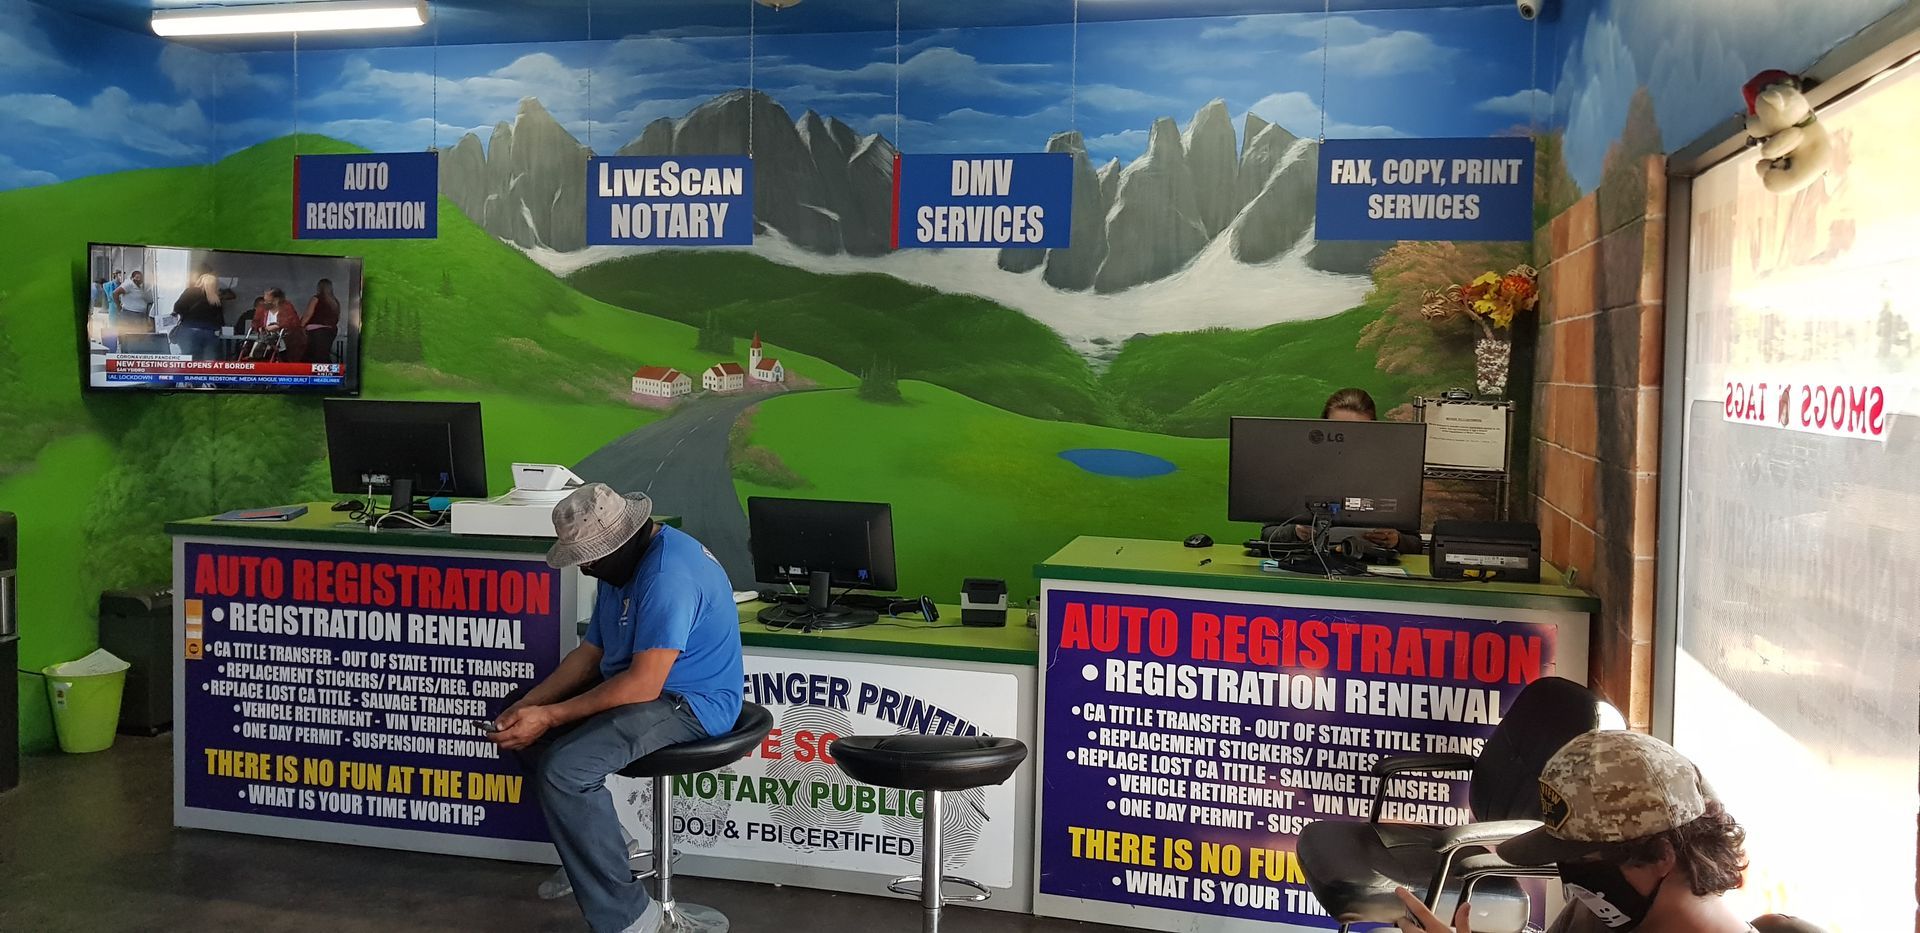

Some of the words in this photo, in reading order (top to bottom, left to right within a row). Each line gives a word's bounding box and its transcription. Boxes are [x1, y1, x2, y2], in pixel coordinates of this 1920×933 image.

[343, 161, 389, 191] AUTO
[951, 159, 1014, 197] DMV
[1330, 159, 1377, 187] FAX,
[1382, 158, 1446, 187] COPY,
[1451, 158, 1523, 185] PRINT
[306, 201, 426, 230] REGISTRATION
[610, 202, 729, 239] NOTARY
[916, 205, 1044, 243] SERVICES
[1368, 193, 1480, 220] SERVICES
[169, 361, 186, 369] SITE
[312, 363, 329, 373] FOX
[1327, 432, 1345, 443] LG
[194, 553, 284, 600] AUTO
[293, 559, 550, 615] REGISTRATION
[229, 602, 401, 642] REGISTRATION
[407, 613, 525, 650] RENEWAL
[1060, 602, 1179, 657] AUTO
[1191, 612, 1543, 685] REGISTRATION
[213, 640, 231, 658] CA
[233, 642, 266, 661] TITLE
[268, 645, 332, 666] TRANSFER
[342, 650, 368, 668] OUT
[370, 652, 387, 669] OF
[388, 653, 427, 673] STATE
[429, 656, 464, 675] TITLE
[466, 659, 535, 680] TRANSFER
[226, 662, 313, 685] REPLACEMENT
[315, 669, 384, 690] STICKERS/
[210, 679, 264, 700] REPLACE
[265, 684, 296, 702] LOST
[298, 686, 317, 704] CA
[318, 688, 351, 707] TITLE
[361, 691, 417, 711] SALVAGE
[419, 696, 487, 717] TRANSFER
[1105, 658, 1337, 712] REGISTRATION
[1345, 678, 1504, 726] RENEWAL
[242, 701, 293, 721] VEHICLE
[294, 706, 373, 727] RETIREMENT
[385, 713, 409, 731] VIN
[1083, 702, 1106, 723] CA
[1109, 704, 1153, 728] TITLE
[1156, 709, 1241, 736] TRANSFER
[1255, 718, 1290, 740] OUT
[1293, 722, 1315, 743] OF
[1318, 724, 1370, 748] STATE
[1373, 729, 1420, 753] TITLE
[1424, 733, 1488, 759] TRANS
[242, 722, 267, 740] ONE
[269, 724, 294, 742] DAY
[295, 727, 343, 746] PERMIT
[352, 731, 435, 754] SUSPENSION
[437, 738, 500, 760] REMOVAL
[1099, 727, 1216, 757] REPLACEMENT
[1219, 739, 1312, 767] STICKERS/
[204, 748, 271, 781] THERE
[275, 755, 299, 784] IS
[303, 757, 334, 787] NO
[339, 761, 382, 792] FUN
[386, 765, 415, 794] AT
[419, 768, 462, 799] THE
[467, 772, 523, 804] DMV
[1077, 747, 1148, 772] REPLACE
[1151, 754, 1192, 776] LOST
[1195, 759, 1219, 780] CA
[1221, 762, 1266, 784] TITLE
[1280, 767, 1355, 793] SALVAGE
[1359, 775, 1450, 803] TRANSFER
[1119, 773, 1187, 798] VEHICLE
[1190, 781, 1296, 810] RETIREMENT
[1312, 793, 1344, 815] VIN
[248, 784, 297, 808] WHAT
[298, 789, 315, 810] IS
[318, 791, 363, 815] YOUR
[366, 795, 407, 819] TIME
[409, 799, 486, 827] WORTH?
[672, 771, 802, 807] NOTARY
[811, 781, 925, 820] PUBLIC
[1119, 797, 1152, 819] ONE
[1154, 800, 1187, 823] DAY
[1190, 805, 1255, 830] PERMIT
[672, 815, 717, 837] DOJ
[723, 819, 740, 840] &
[747, 822, 783, 844] FBI
[789, 826, 915, 857] CERTIFIED
[1068, 825, 1156, 867] THERE
[1163, 837, 1194, 871] IS
[1200, 841, 1242, 878] NO
[1249, 847, 1306, 885] FUN
[1125, 869, 1189, 900] WHAT
[1193, 877, 1216, 903] IS
[1221, 881, 1280, 910] YOUR
[1285, 888, 1331, 918] TIM
